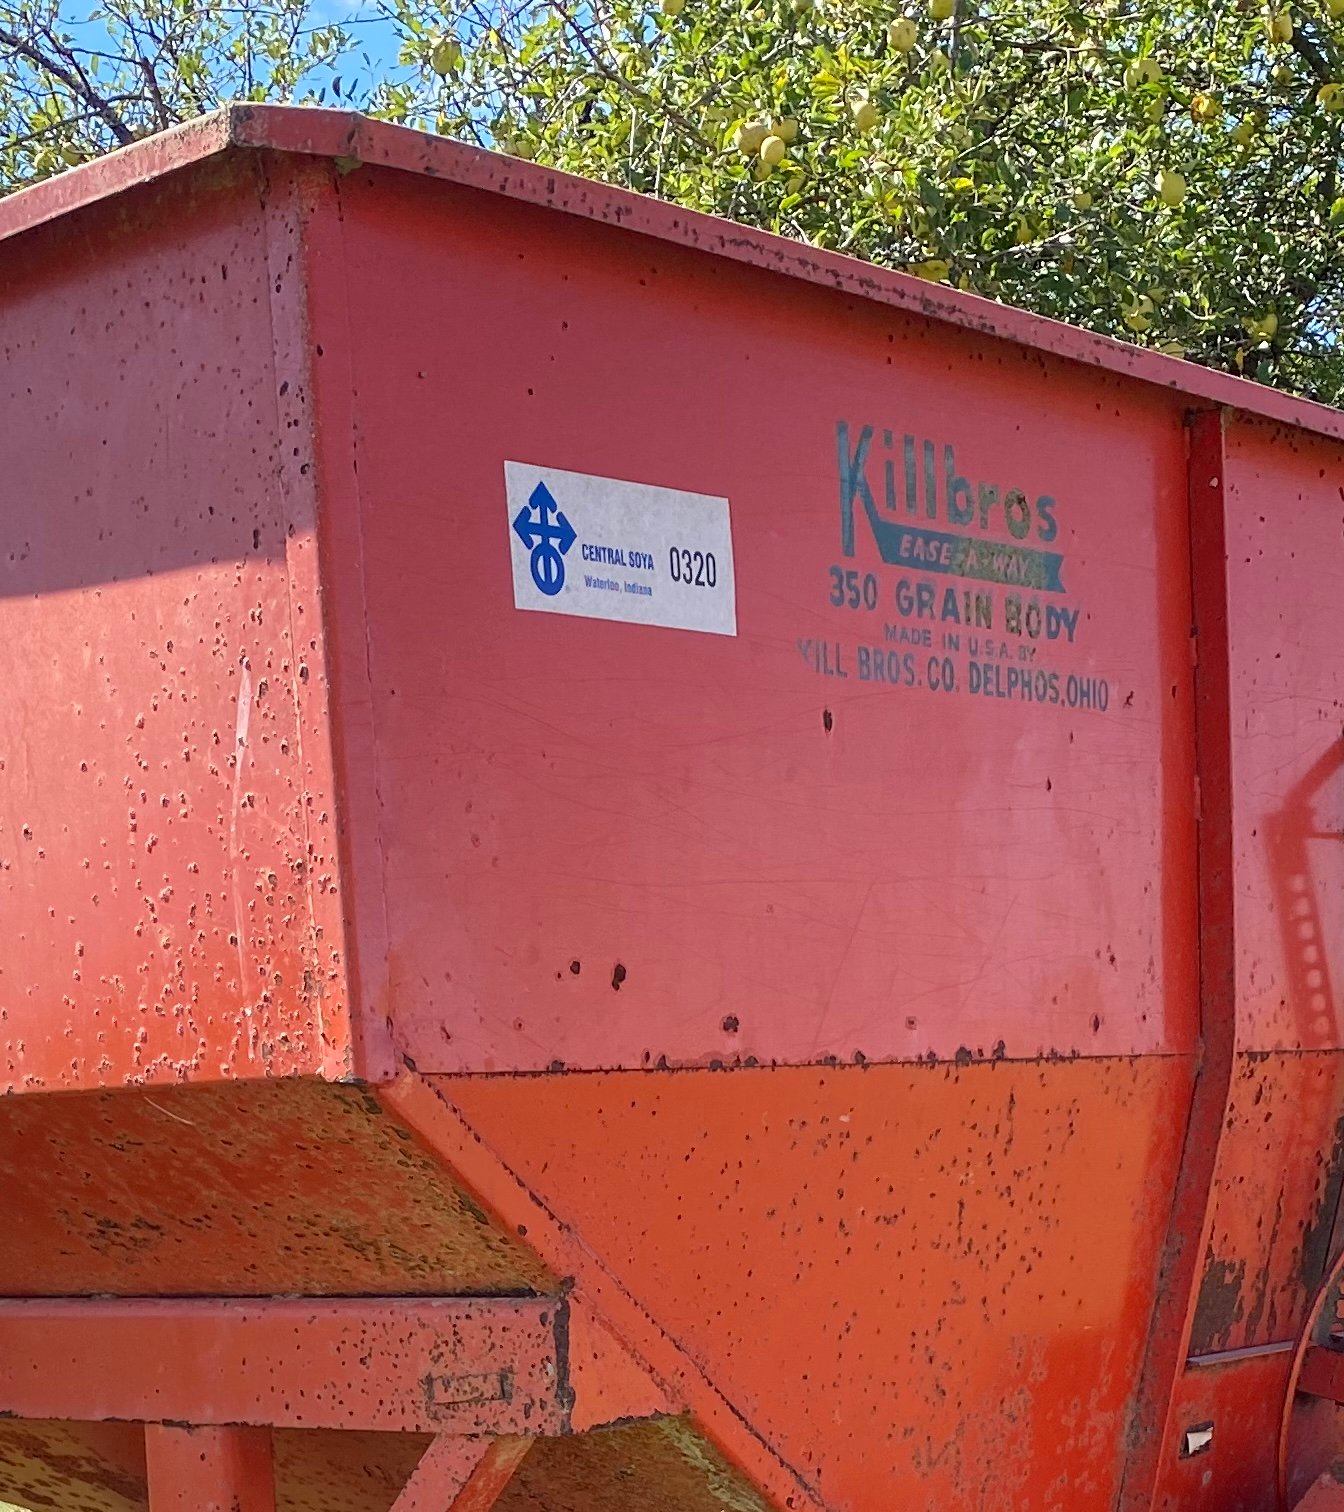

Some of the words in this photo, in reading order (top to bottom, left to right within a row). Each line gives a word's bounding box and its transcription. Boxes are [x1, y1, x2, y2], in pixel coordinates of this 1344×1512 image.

[837, 420, 1057, 557] Killbros
[581, 543, 627, 567] CENTRAL
[628, 551, 655, 571] SOYA
[669, 546, 716, 588] 0320
[624, 581, 653, 597] Indiana
[828, 565, 878, 611] 350
[895, 579, 993, 630] GRAIN
[1004, 593, 1080, 643] BODY
[884, 622, 932, 648] MADE
[943, 632, 960, 652] IN
[1018, 644, 1037, 662] BY
